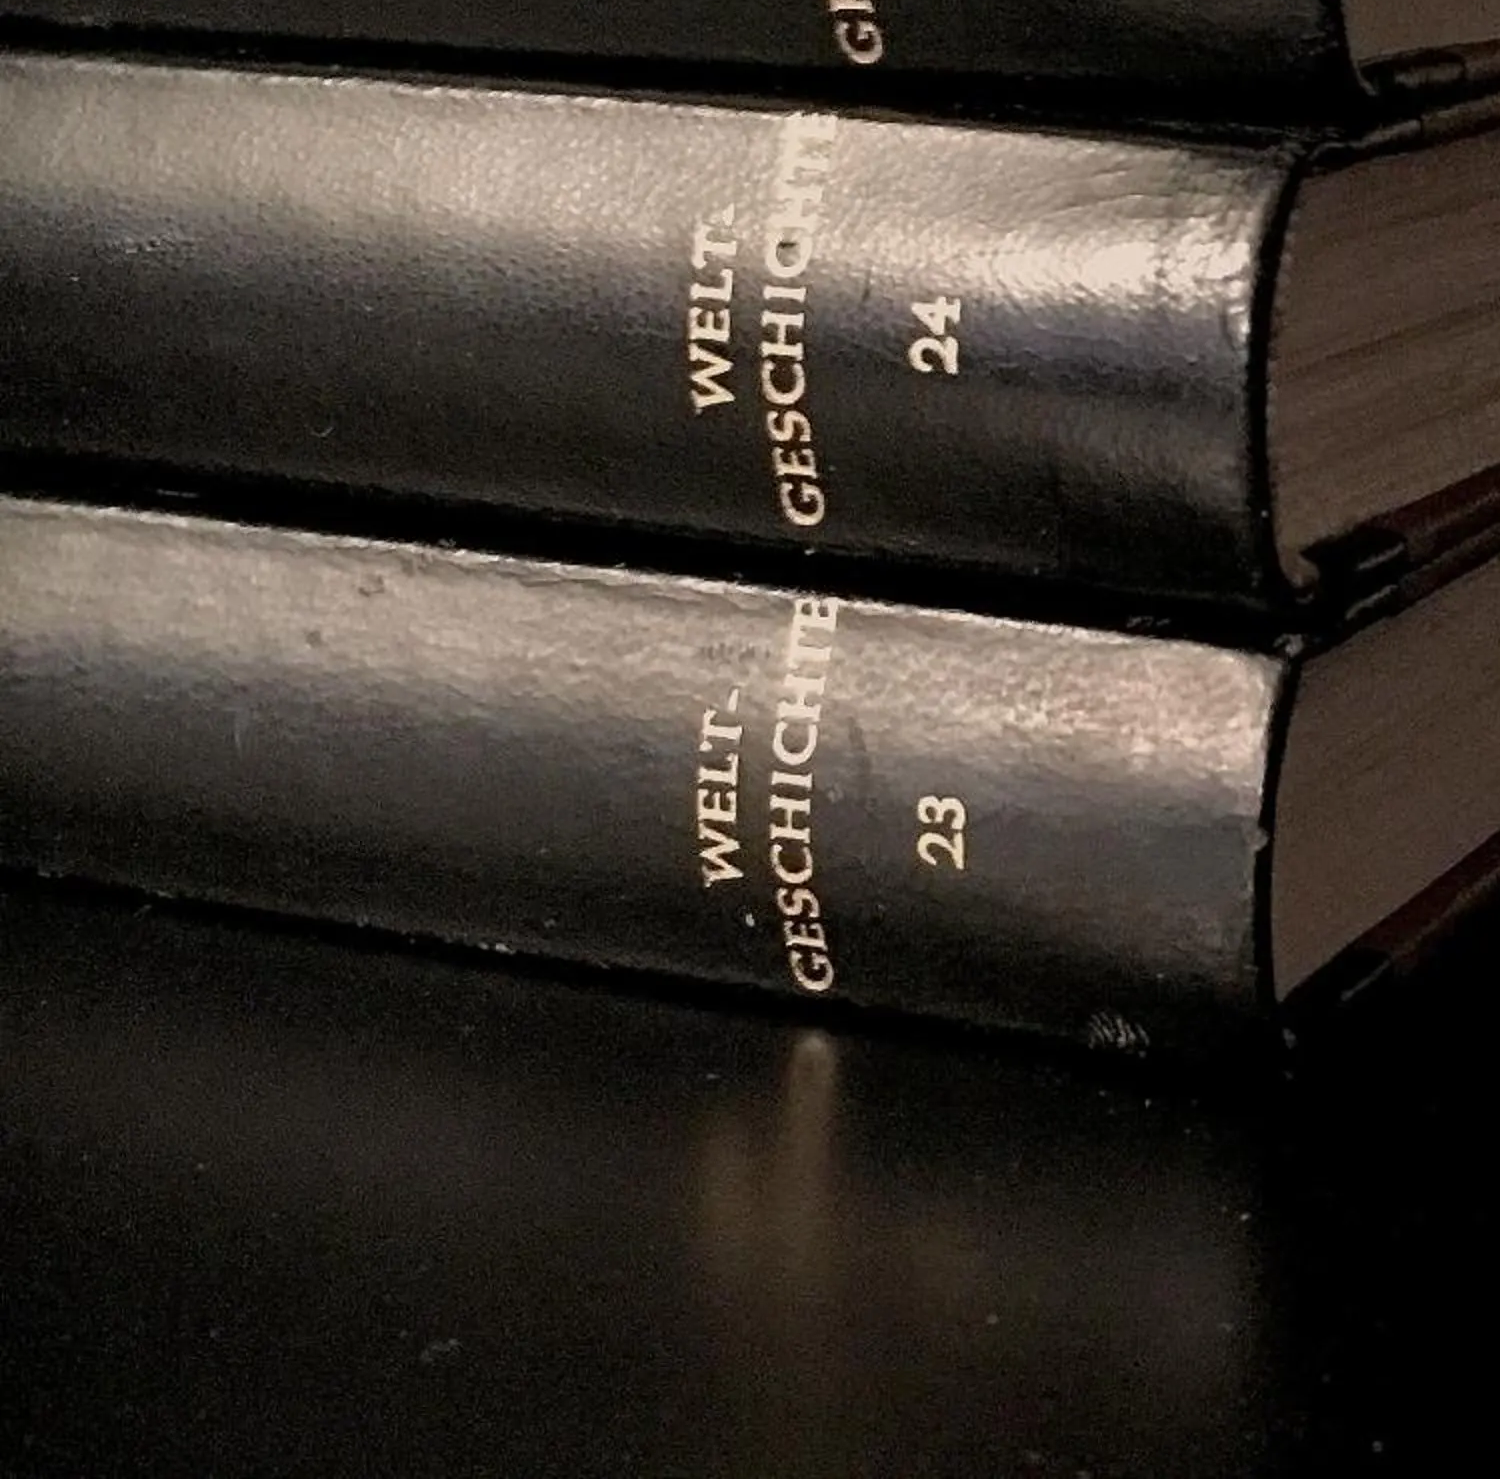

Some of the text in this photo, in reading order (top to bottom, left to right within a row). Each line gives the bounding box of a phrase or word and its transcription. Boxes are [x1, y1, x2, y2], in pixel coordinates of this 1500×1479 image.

[687, 203, 738, 415] WELT-
[908, 296, 961, 375] 24
[697, 686, 744, 888] WELT-
[769, 596, 838, 992] GESCHICHTE
[917, 795, 967, 871] 23
